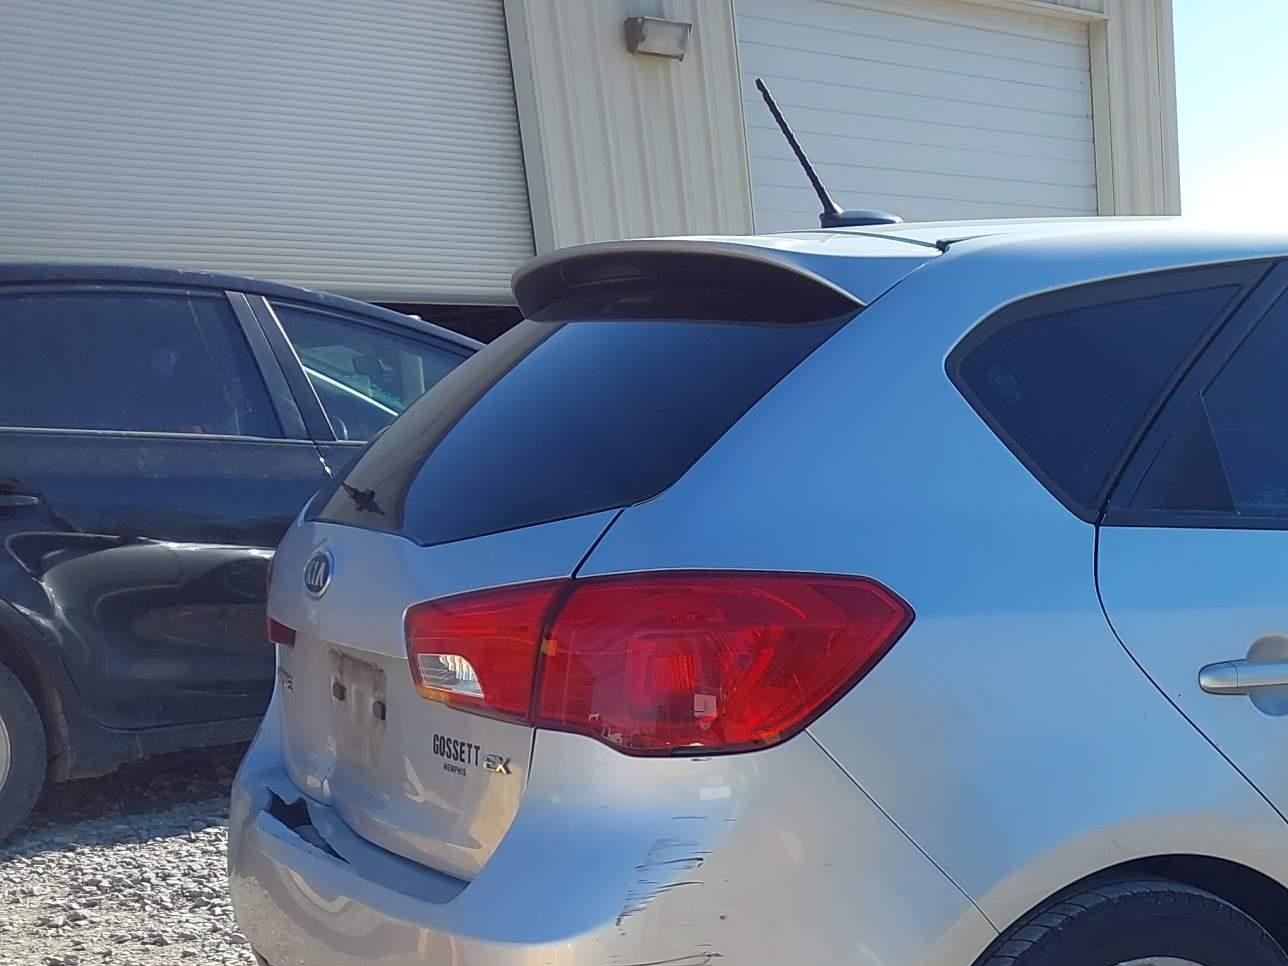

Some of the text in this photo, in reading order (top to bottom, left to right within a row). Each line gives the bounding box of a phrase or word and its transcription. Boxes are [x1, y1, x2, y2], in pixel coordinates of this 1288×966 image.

[433, 733, 480, 766] GOSSETT
[443, 762, 466, 776] MEMPHIS
[483, 754, 512, 775] EX
